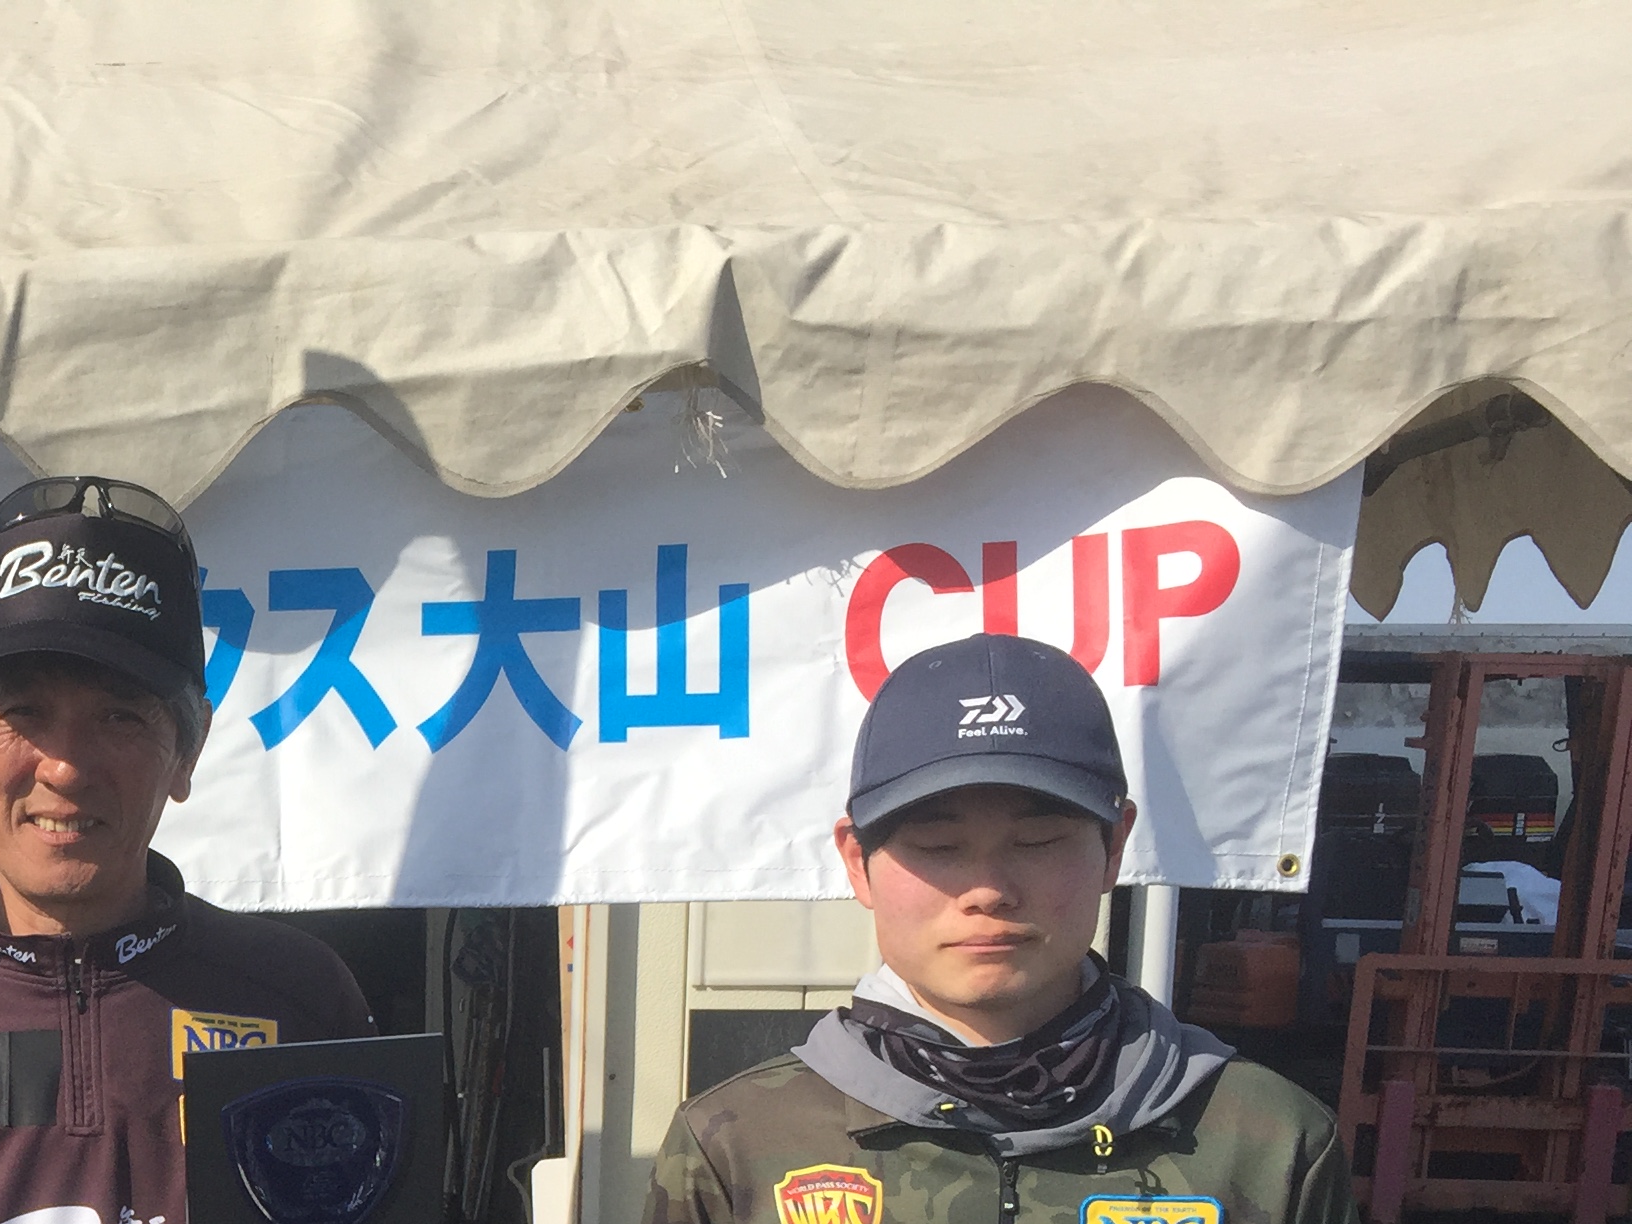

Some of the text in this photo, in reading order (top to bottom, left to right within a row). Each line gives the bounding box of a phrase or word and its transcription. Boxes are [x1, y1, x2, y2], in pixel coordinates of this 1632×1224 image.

[0, 541, 162, 605] Benten
[78, 592, 162, 621] Fishing
[845, 520, 1241, 704] CUP
[958, 725, 1028, 739] Feel Alive.
[787, 1181, 815, 1195] WORLD
[835, 1180, 869, 1193] SOCIETY
